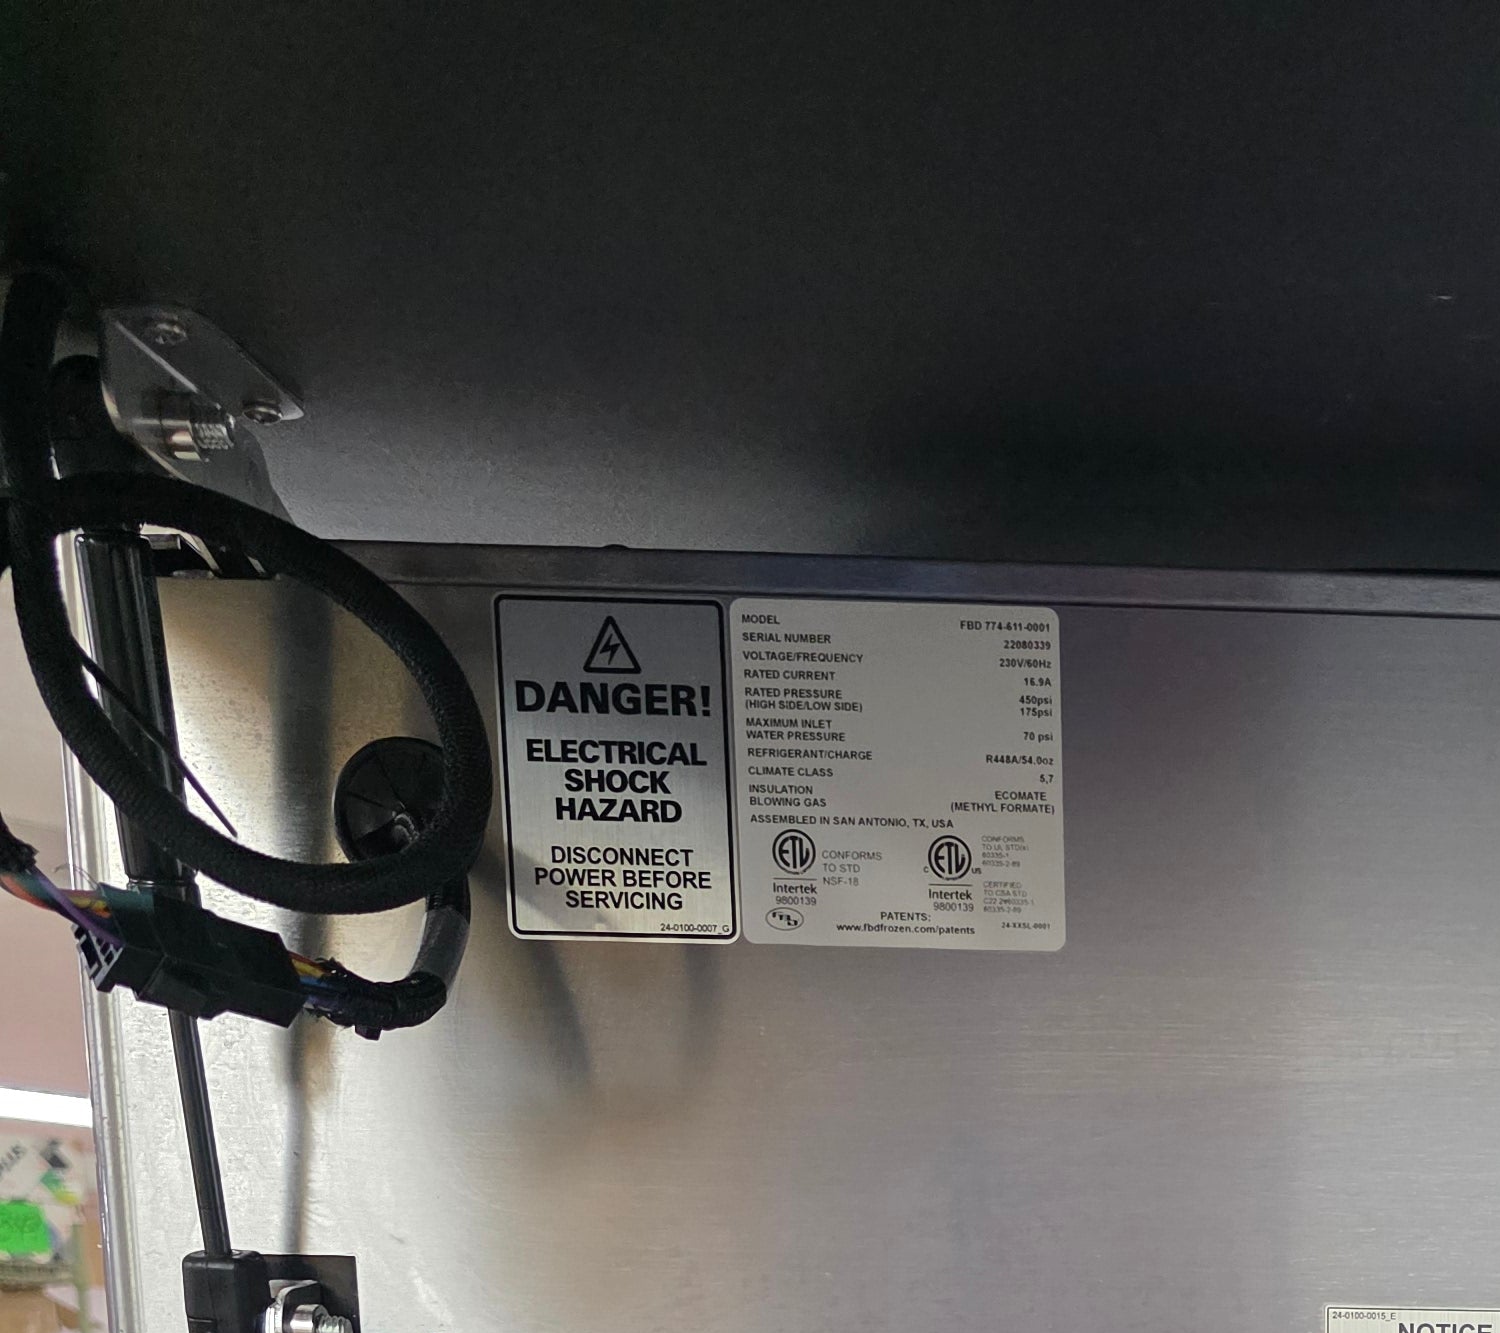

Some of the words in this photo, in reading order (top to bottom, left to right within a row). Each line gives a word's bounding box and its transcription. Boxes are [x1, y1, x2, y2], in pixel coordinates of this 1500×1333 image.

[741, 613, 780, 625] MODEL
[959, 619, 982, 630] FBD
[984, 620, 1050, 632] 774-611-0001
[741, 631, 782, 642] SERIAL
[783, 633, 831, 644] NUMBER
[741, 650, 863, 663] VOLTAGE/FREQUENCY
[998, 657, 1052, 669] 230V/60Hz
[743, 668, 780, 679] RATED
[782, 669, 836, 680] CURRENT
[514, 680, 711, 716] DANGER!
[744, 686, 781, 697] RATED
[783, 687, 842, 699] PRESSURE
[744, 698, 776, 709] (HIGH
[833, 701, 863, 712] SIDE)
[1018, 694, 1052, 706] 450psi
[1020, 706, 1052, 718] 175psi
[745, 717, 798, 728] MAXIMUM
[800, 718, 832, 729] INLET
[745, 729, 784, 740] WATER
[786, 730, 845, 741] PRESSURE
[1023, 730, 1035, 741] 70
[1037, 732, 1053, 743] psi
[525, 738, 707, 765] ELECTRICAL
[747, 747, 872, 760] REFRIGERANT/CHARGE
[747, 765, 795, 776] CLIMATE
[796, 767, 834, 777] CLASS
[564, 768, 672, 794] SHOCK
[748, 784, 813, 794] INSULATION
[749, 795, 801, 807] BLOWING
[803, 797, 826, 807] GAS
[994, 790, 1047, 801] ECOMATE
[555, 797, 682, 823] HAZARD
[950, 801, 998, 812] (METHYL
[1000, 802, 1055, 814] FORMATE)
[750, 814, 817, 824] ASSEMBLED
[819, 815, 830, 825] IN
[832, 815, 855, 825] SAN
[931, 818, 954, 828] USA
[550, 845, 694, 866] DISCONNECT
[821, 849, 882, 861] CONFORMS
[821, 862, 837, 873] TO
[838, 863, 860, 873] STD
[534, 867, 617, 887] POWER
[622, 869, 712, 889] BEFORE
[822, 875, 859, 886] NSF-18
[772, 882, 818, 894] Intertek
[928, 888, 972, 900] Intertek
[565, 890, 683, 910] SERVICING
[775, 895, 817, 906] 9800139
[932, 901, 974, 912] 9800139
[880, 911, 931, 921] PATENTS:
[660, 923, 730, 934] 24-0100-0007_G
[836, 922, 975, 935] www.fbdfrozen.com/patents
[1331, 1310, 1396, 1322] 24-0100-0015_E
